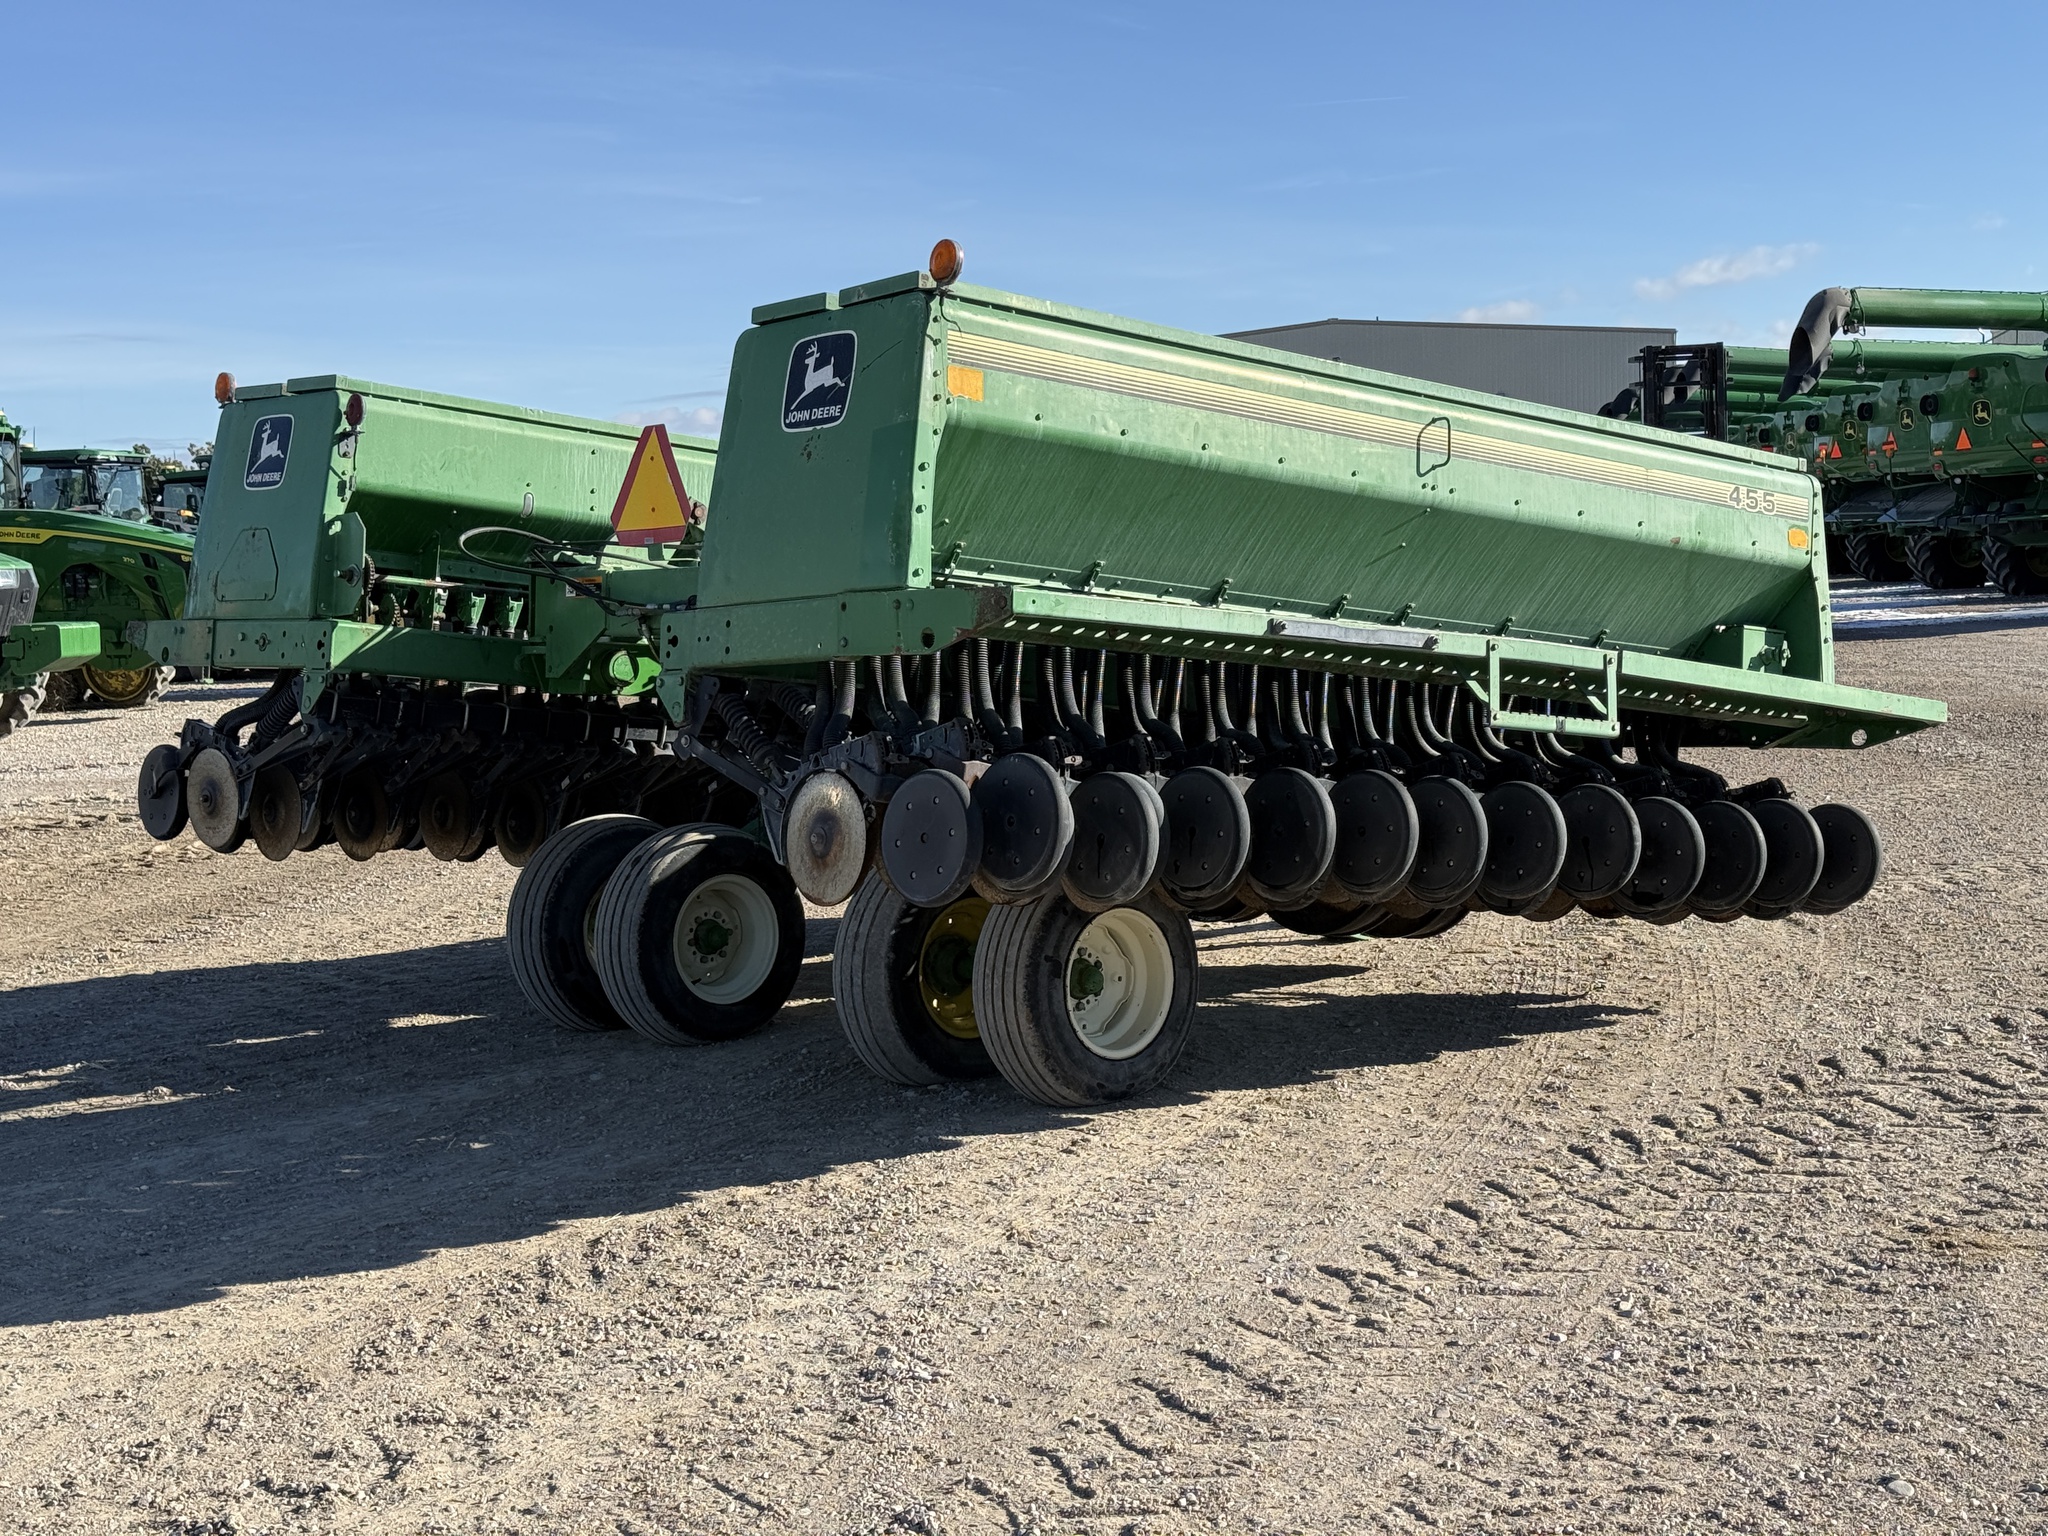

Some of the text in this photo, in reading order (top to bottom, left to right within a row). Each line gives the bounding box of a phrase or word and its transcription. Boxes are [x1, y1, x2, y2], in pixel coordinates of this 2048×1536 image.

[785, 404, 842, 424] JOHN DEERE
[247, 471, 282, 483] JOHN DEERE
[1728, 486, 1776, 513] 455
[15, 530, 41, 539] DEERE
